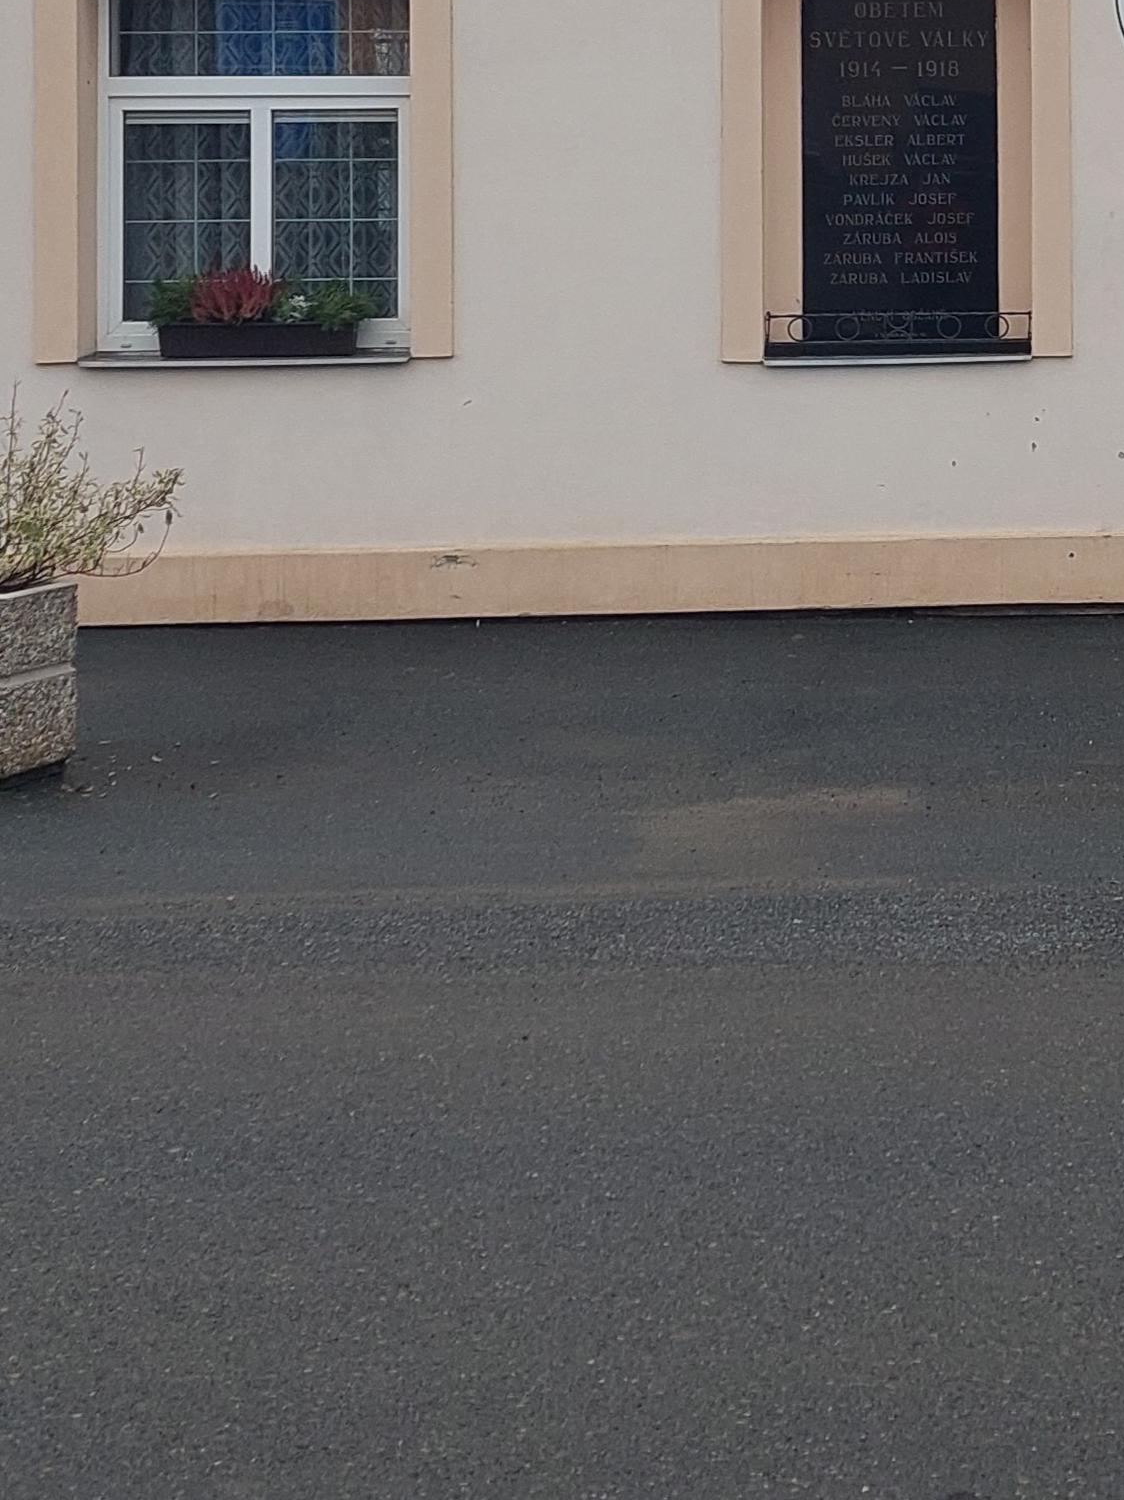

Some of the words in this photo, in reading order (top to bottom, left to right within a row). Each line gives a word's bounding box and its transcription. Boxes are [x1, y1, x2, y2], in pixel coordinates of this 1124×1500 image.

[840, 60, 881, 78] 1914
[917, 60, 959, 77] 1918
[834, 134, 894, 148] EKSLER
[907, 133, 965, 146] ALBERT
[842, 152, 892, 166] HUŠEK
[849, 173, 909, 186] KREJZA
[922, 172, 951, 185] JAN
[908, 192, 957, 205] JOSEF
[927, 212, 976, 225] JOSEF
[914, 231, 957, 244] ALOIS
[894, 249, 978, 264] FRANTIŠEK
[900, 271, 973, 284] LADISLAV
